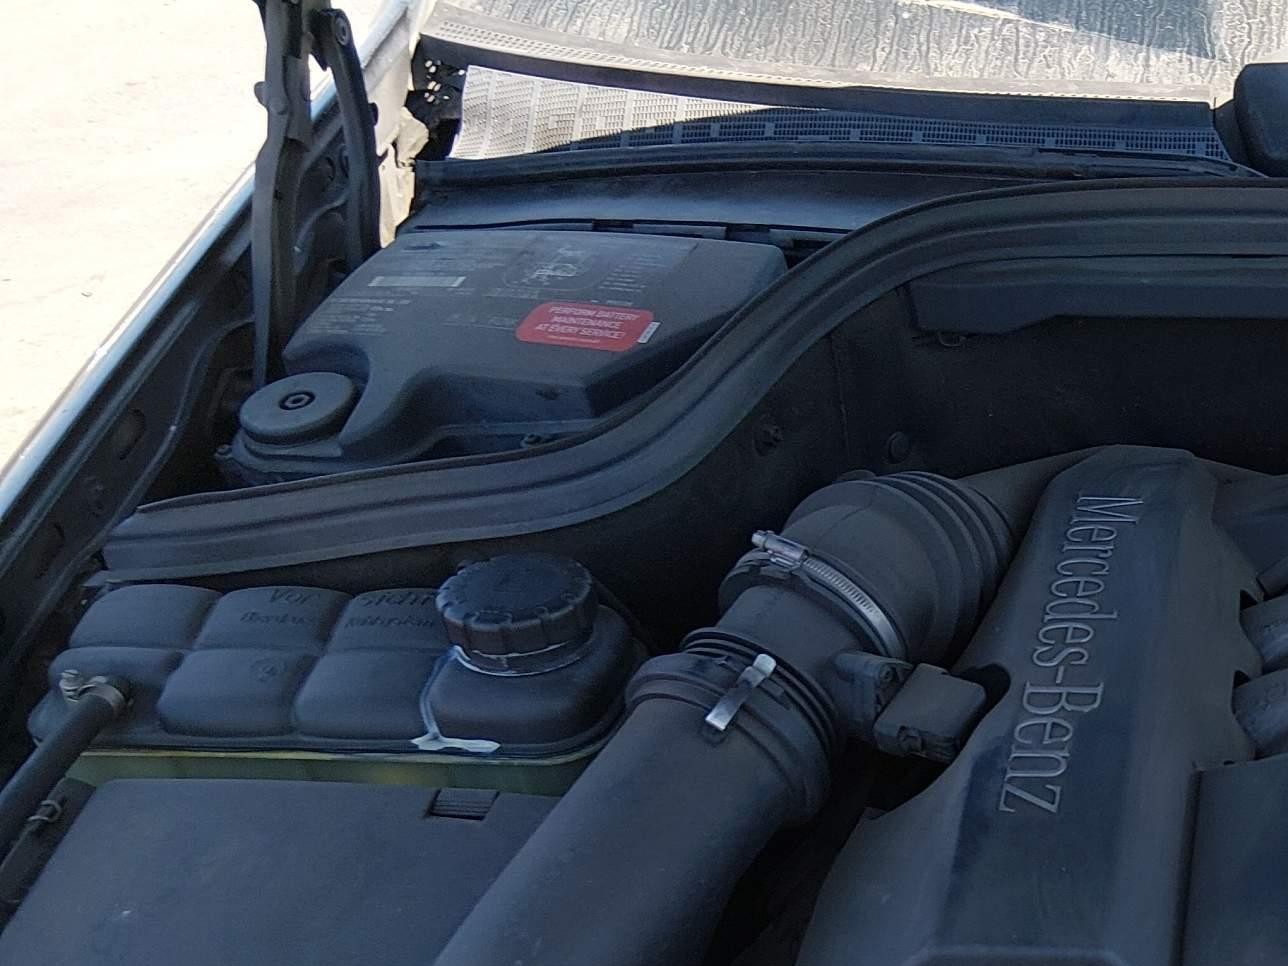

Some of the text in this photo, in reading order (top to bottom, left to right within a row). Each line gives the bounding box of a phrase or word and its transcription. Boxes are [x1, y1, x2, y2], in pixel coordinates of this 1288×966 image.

[549, 306, 640, 321] PERFORM BATTERY
[549, 324, 578, 334] EVERY
[551, 316, 624, 329] MAINTENANCE
[1000, 496, 1145, 814] Mercedes-Benz
